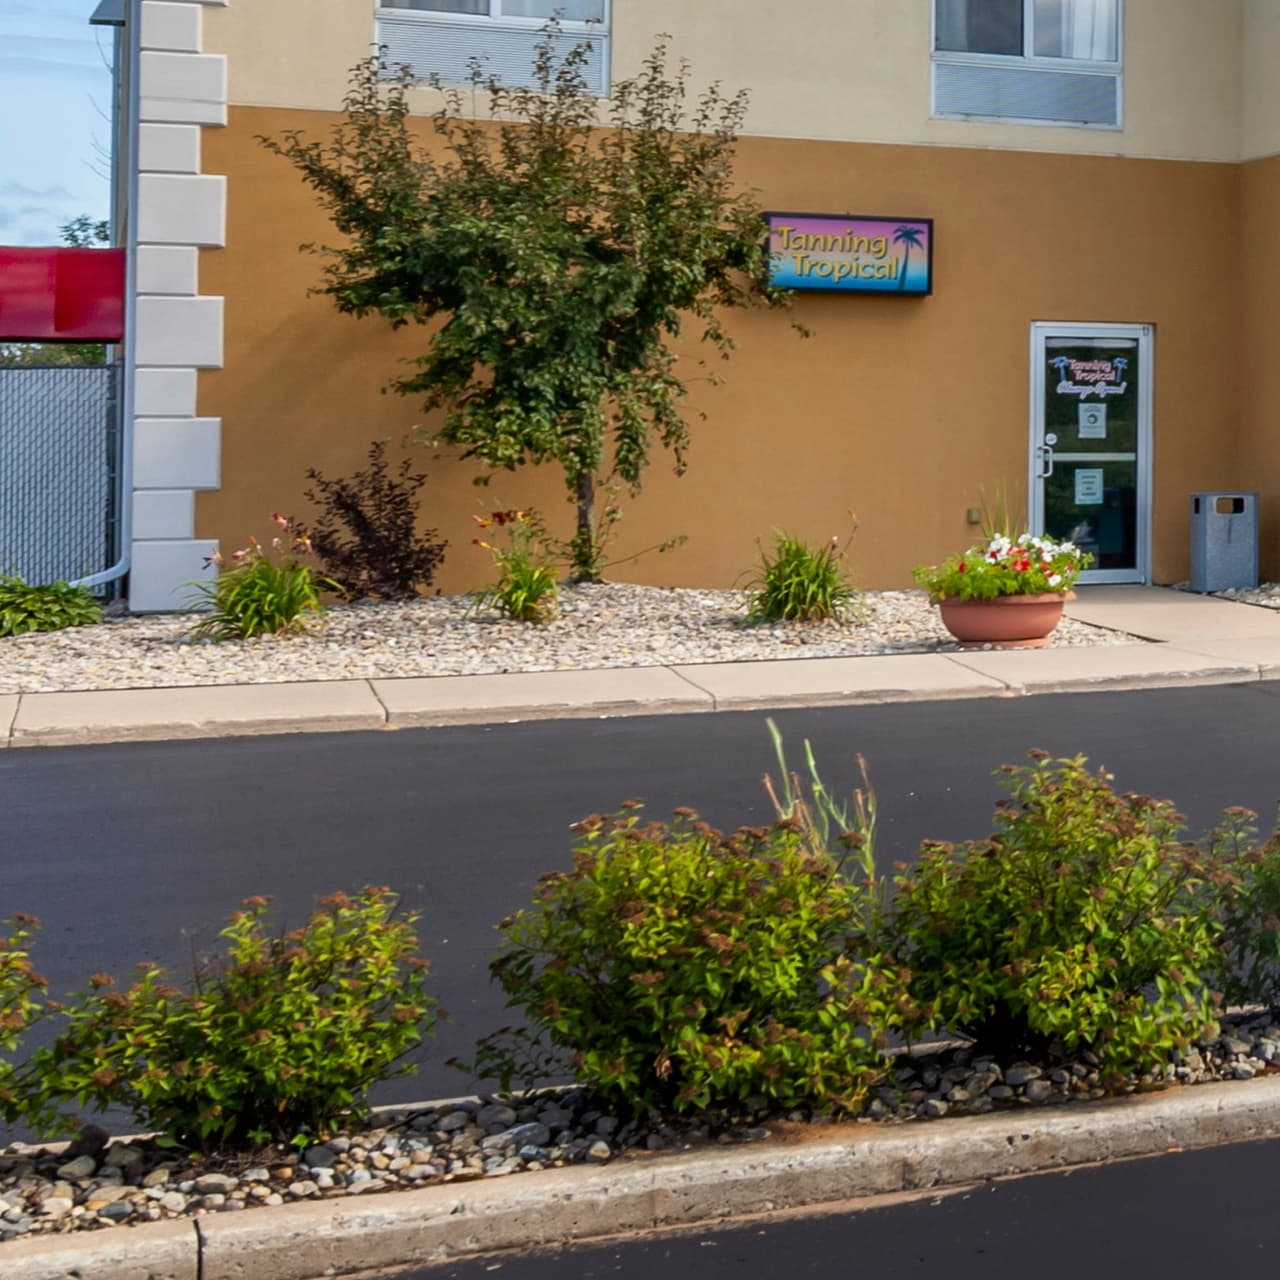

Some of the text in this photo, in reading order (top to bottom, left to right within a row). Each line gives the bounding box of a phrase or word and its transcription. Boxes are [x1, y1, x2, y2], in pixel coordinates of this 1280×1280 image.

[775, 225, 888, 259] Tanning
[792, 252, 899, 283] Tropical
[1067, 359, 1112, 373] Tanning
